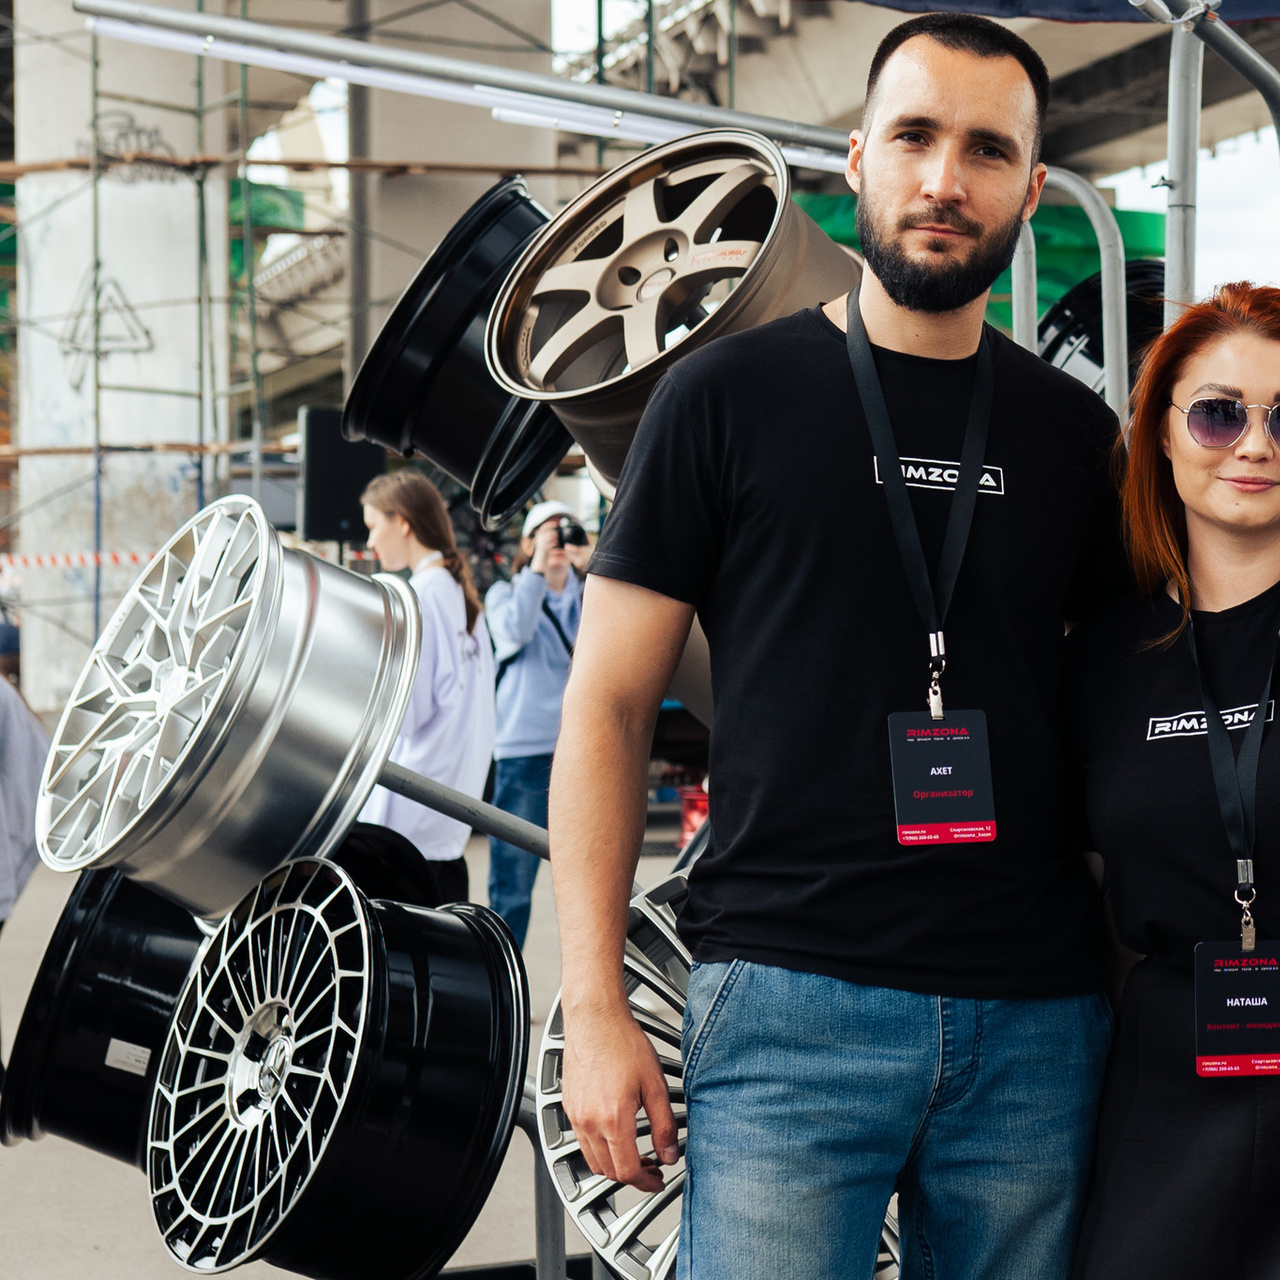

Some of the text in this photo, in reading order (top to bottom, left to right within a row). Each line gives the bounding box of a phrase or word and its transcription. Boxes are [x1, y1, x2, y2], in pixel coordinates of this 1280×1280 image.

[906, 727, 968, 736] RIMZONA
[913, 790, 973, 799] Организатор
[1214, 958, 1277, 967] RIMZONA
[1226, 997, 1267, 1006] НАТАША
